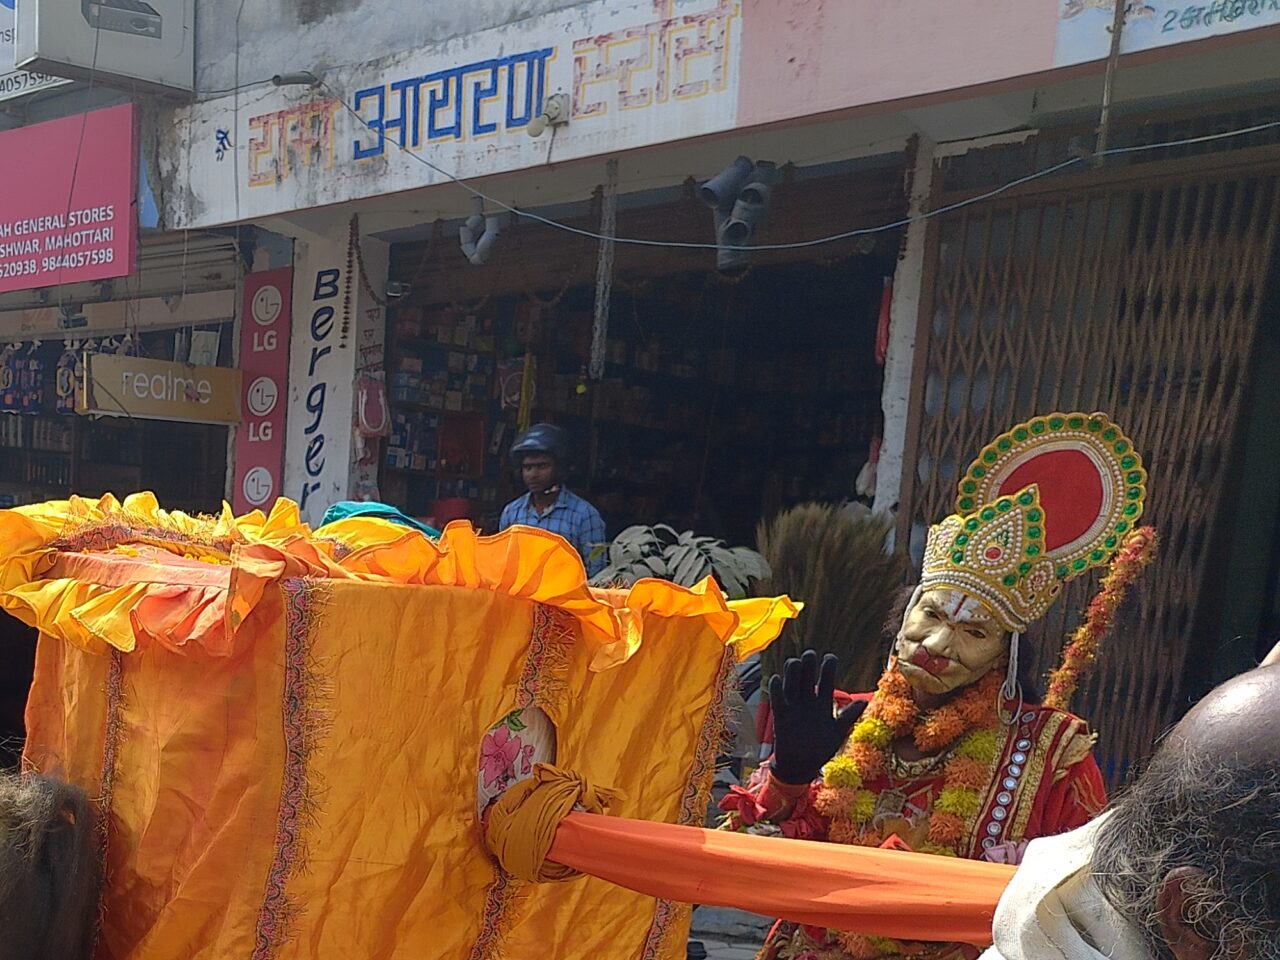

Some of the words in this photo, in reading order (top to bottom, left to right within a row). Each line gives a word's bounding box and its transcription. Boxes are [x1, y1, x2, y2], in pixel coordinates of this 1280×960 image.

[14, 215, 66, 236] GENERAL
[69, 205, 114, 226] STORES
[45, 227, 114, 250] MAHOTTARI
[42, 248, 114, 273] 9844057598
[253, 330, 277, 352] LG
[122, 370, 212, 404] realme
[248, 421, 273, 442] LG
